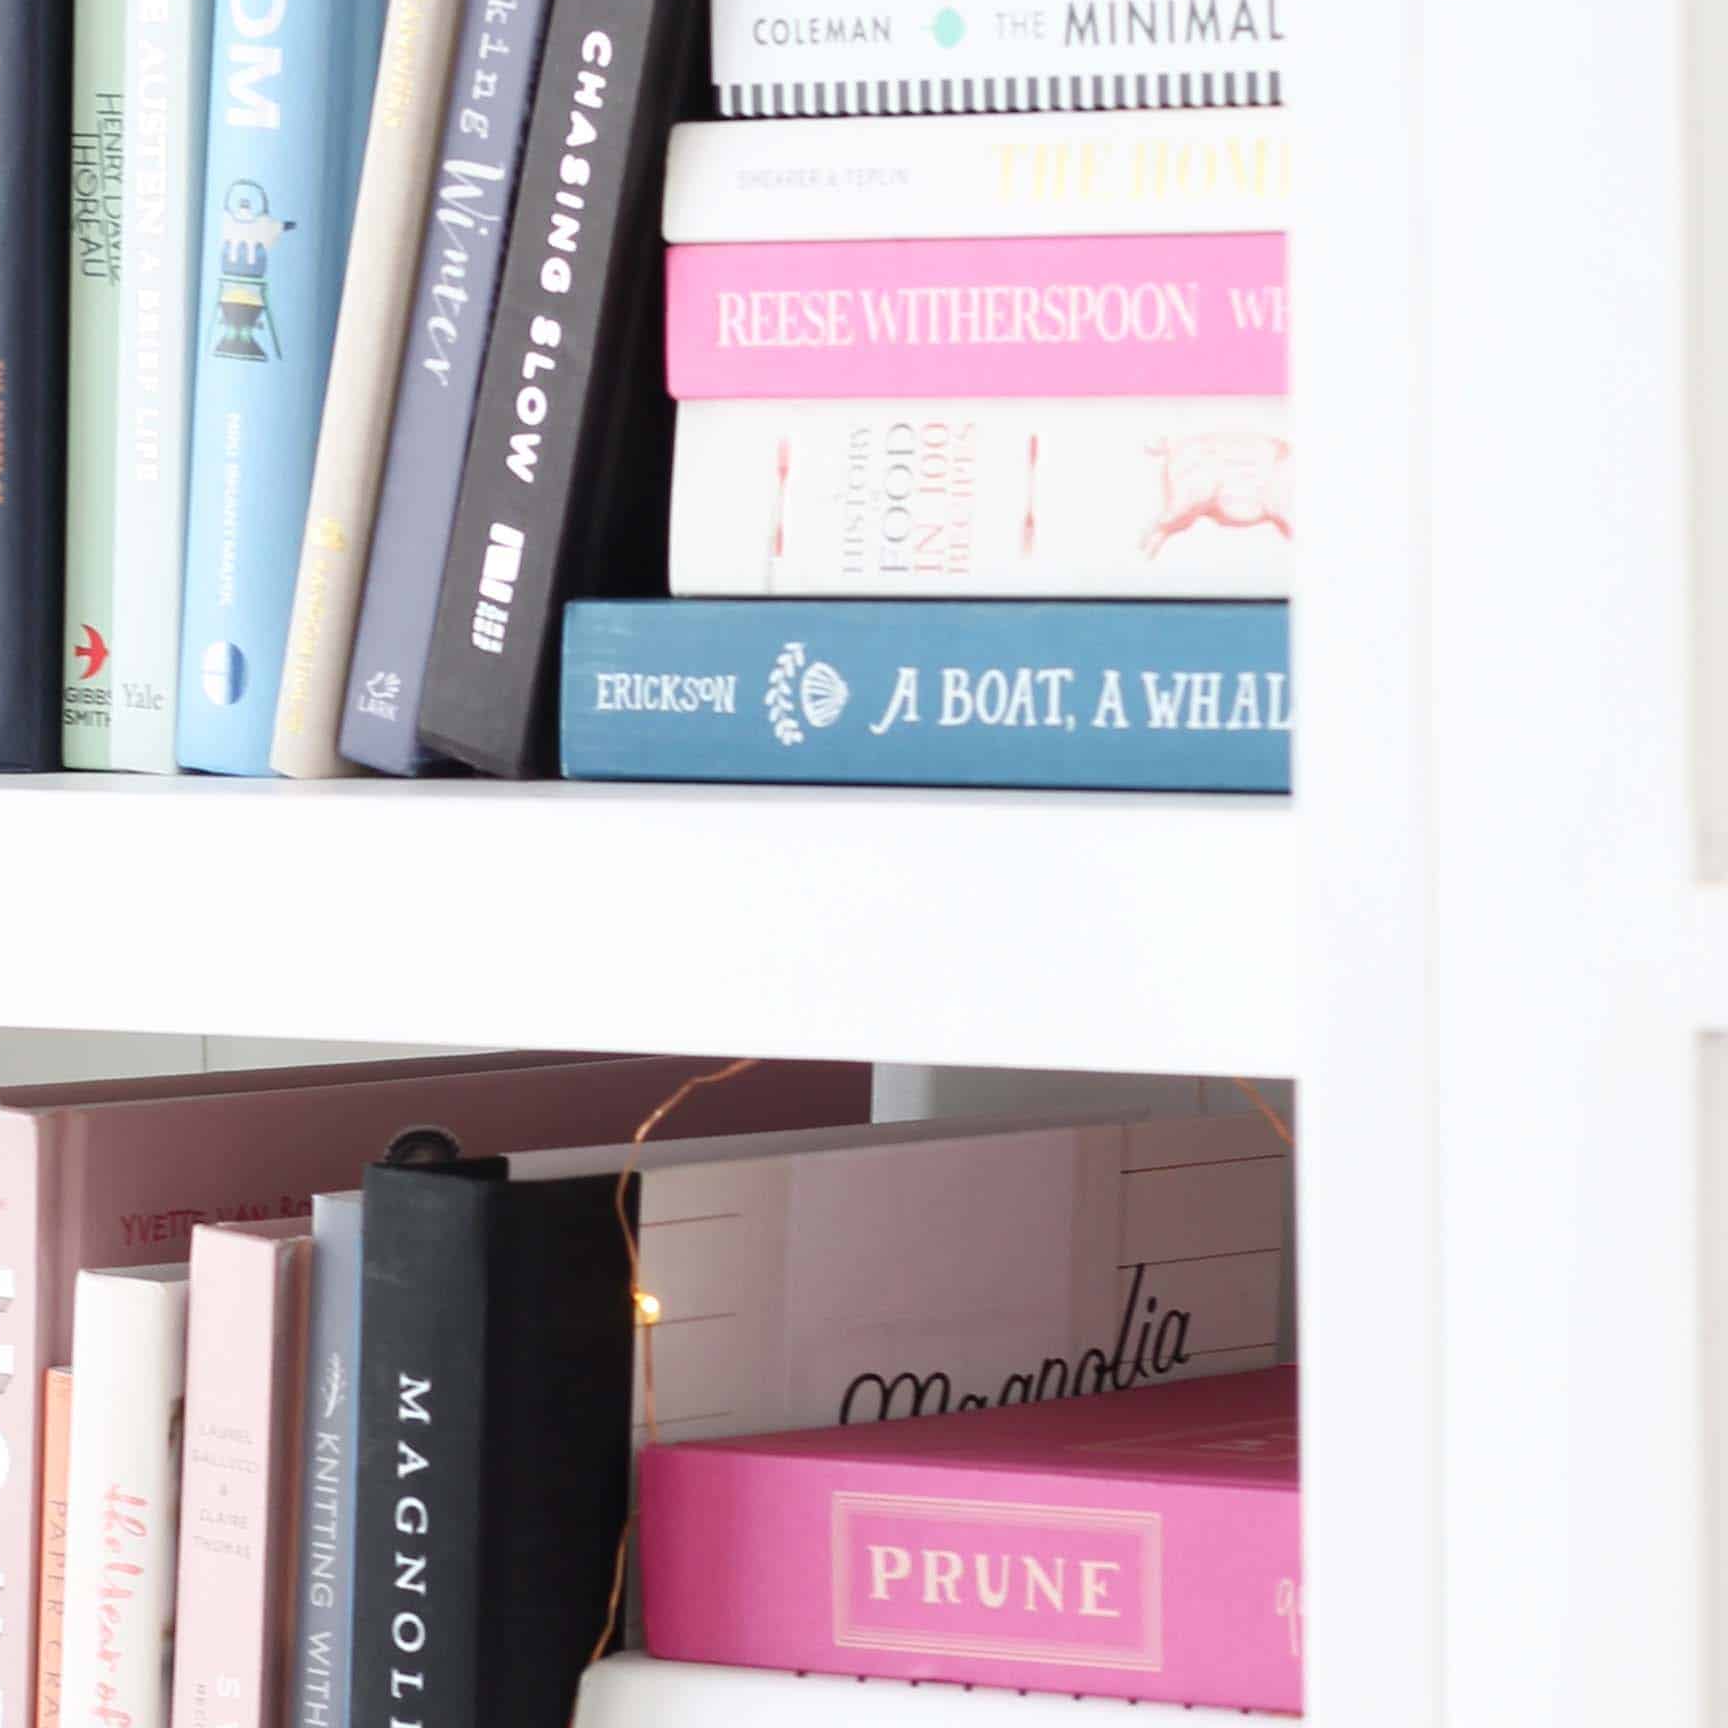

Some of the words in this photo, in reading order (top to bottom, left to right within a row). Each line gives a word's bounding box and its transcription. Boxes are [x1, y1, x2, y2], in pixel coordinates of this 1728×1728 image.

[753, 16, 892, 46] COLEMAN
[995, 12, 1048, 42] THE
[97, 93, 125, 183] HENRY
[136, 41, 169, 239] AUSTEN
[540, 30, 613, 295] CHASING
[992, 143, 1114, 203] THE
[423, 158, 506, 387] Winter
[718, 290, 854, 349] REESE
[862, 282, 1198, 347] WITHERSPOON
[505, 315, 562, 483] SLOW
[843, 426, 872, 573] HISTORY
[879, 422, 917, 573] FOOD
[915, 523, 946, 573] IN
[121, 684, 164, 711] Yale
[596, 674, 736, 713] ERICKSON
[870, 666, 921, 735] A
[939, 668, 1076, 732] BOAT,
[1093, 671, 1130, 729] A
[46, 1499, 68, 1618] PAPER
[309, 1431, 341, 1609] KNITTING
[866, 1544, 1123, 1619] PRUNE
